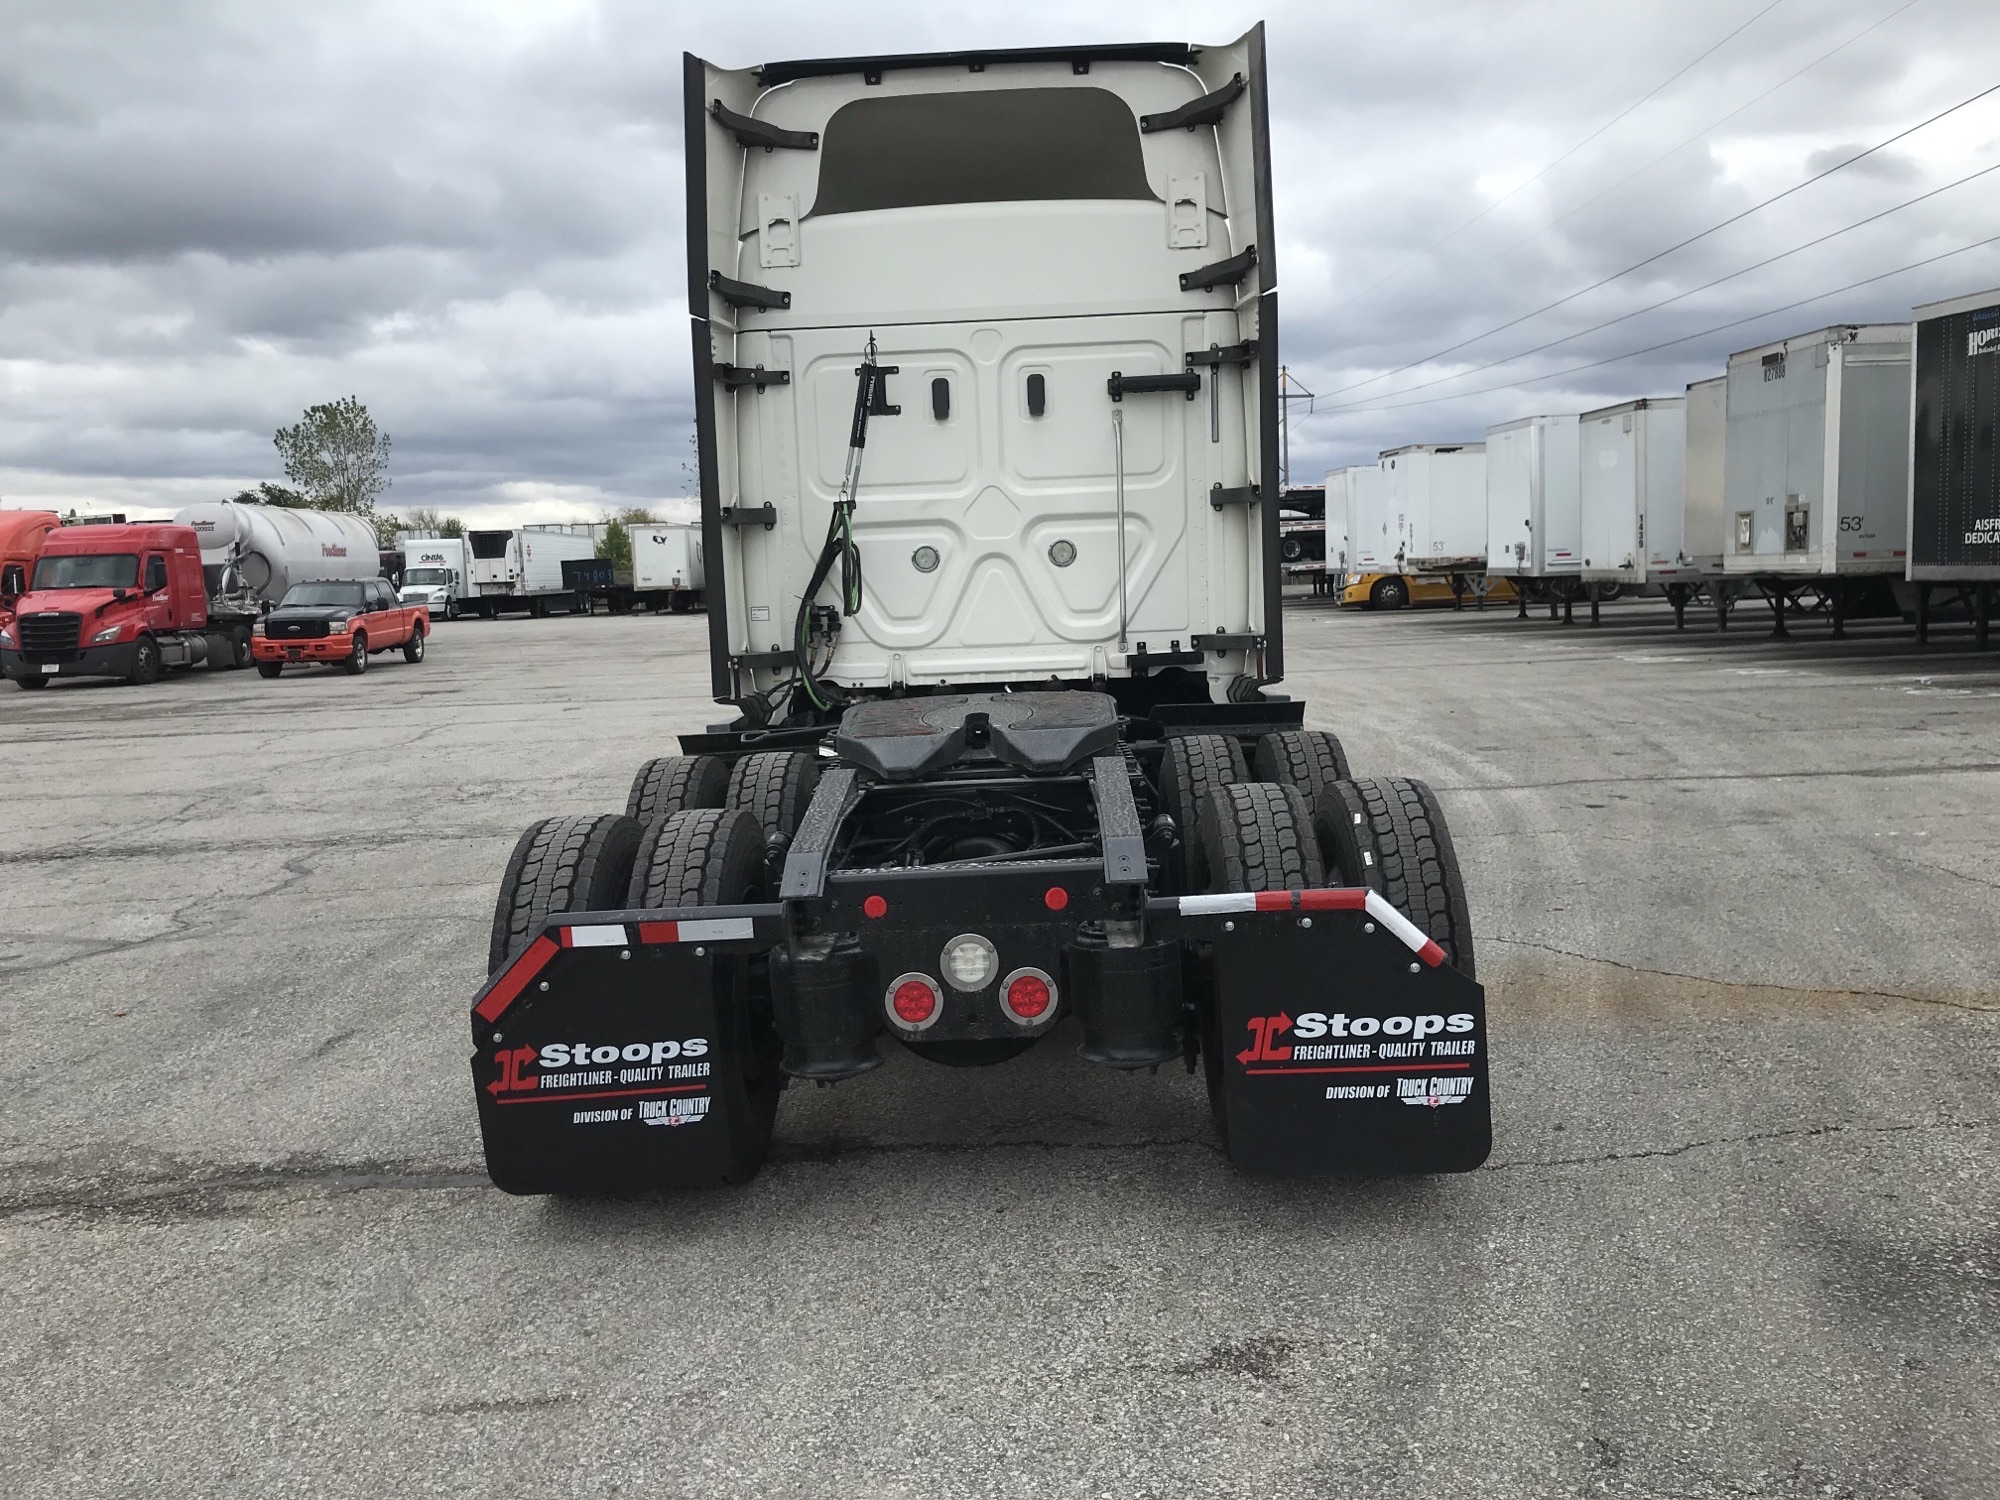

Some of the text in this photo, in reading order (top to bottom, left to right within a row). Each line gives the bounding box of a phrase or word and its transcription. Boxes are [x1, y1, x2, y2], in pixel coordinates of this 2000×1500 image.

[1968, 327, 2000, 356] HORI
[1964, 531, 2000, 544] DEDICA
[1293, 1012, 1475, 1040] Stoops
[538, 1038, 709, 1068] Stoops
[1430, 1040, 1476, 1056] TRAILER
[668, 1062, 711, 1080] TRAILER
[1325, 1076, 1475, 1100] DIVISION OF TRUCK COUNTRY
[572, 1096, 711, 1124] DIVISION OF TRUCK COUNTRY
